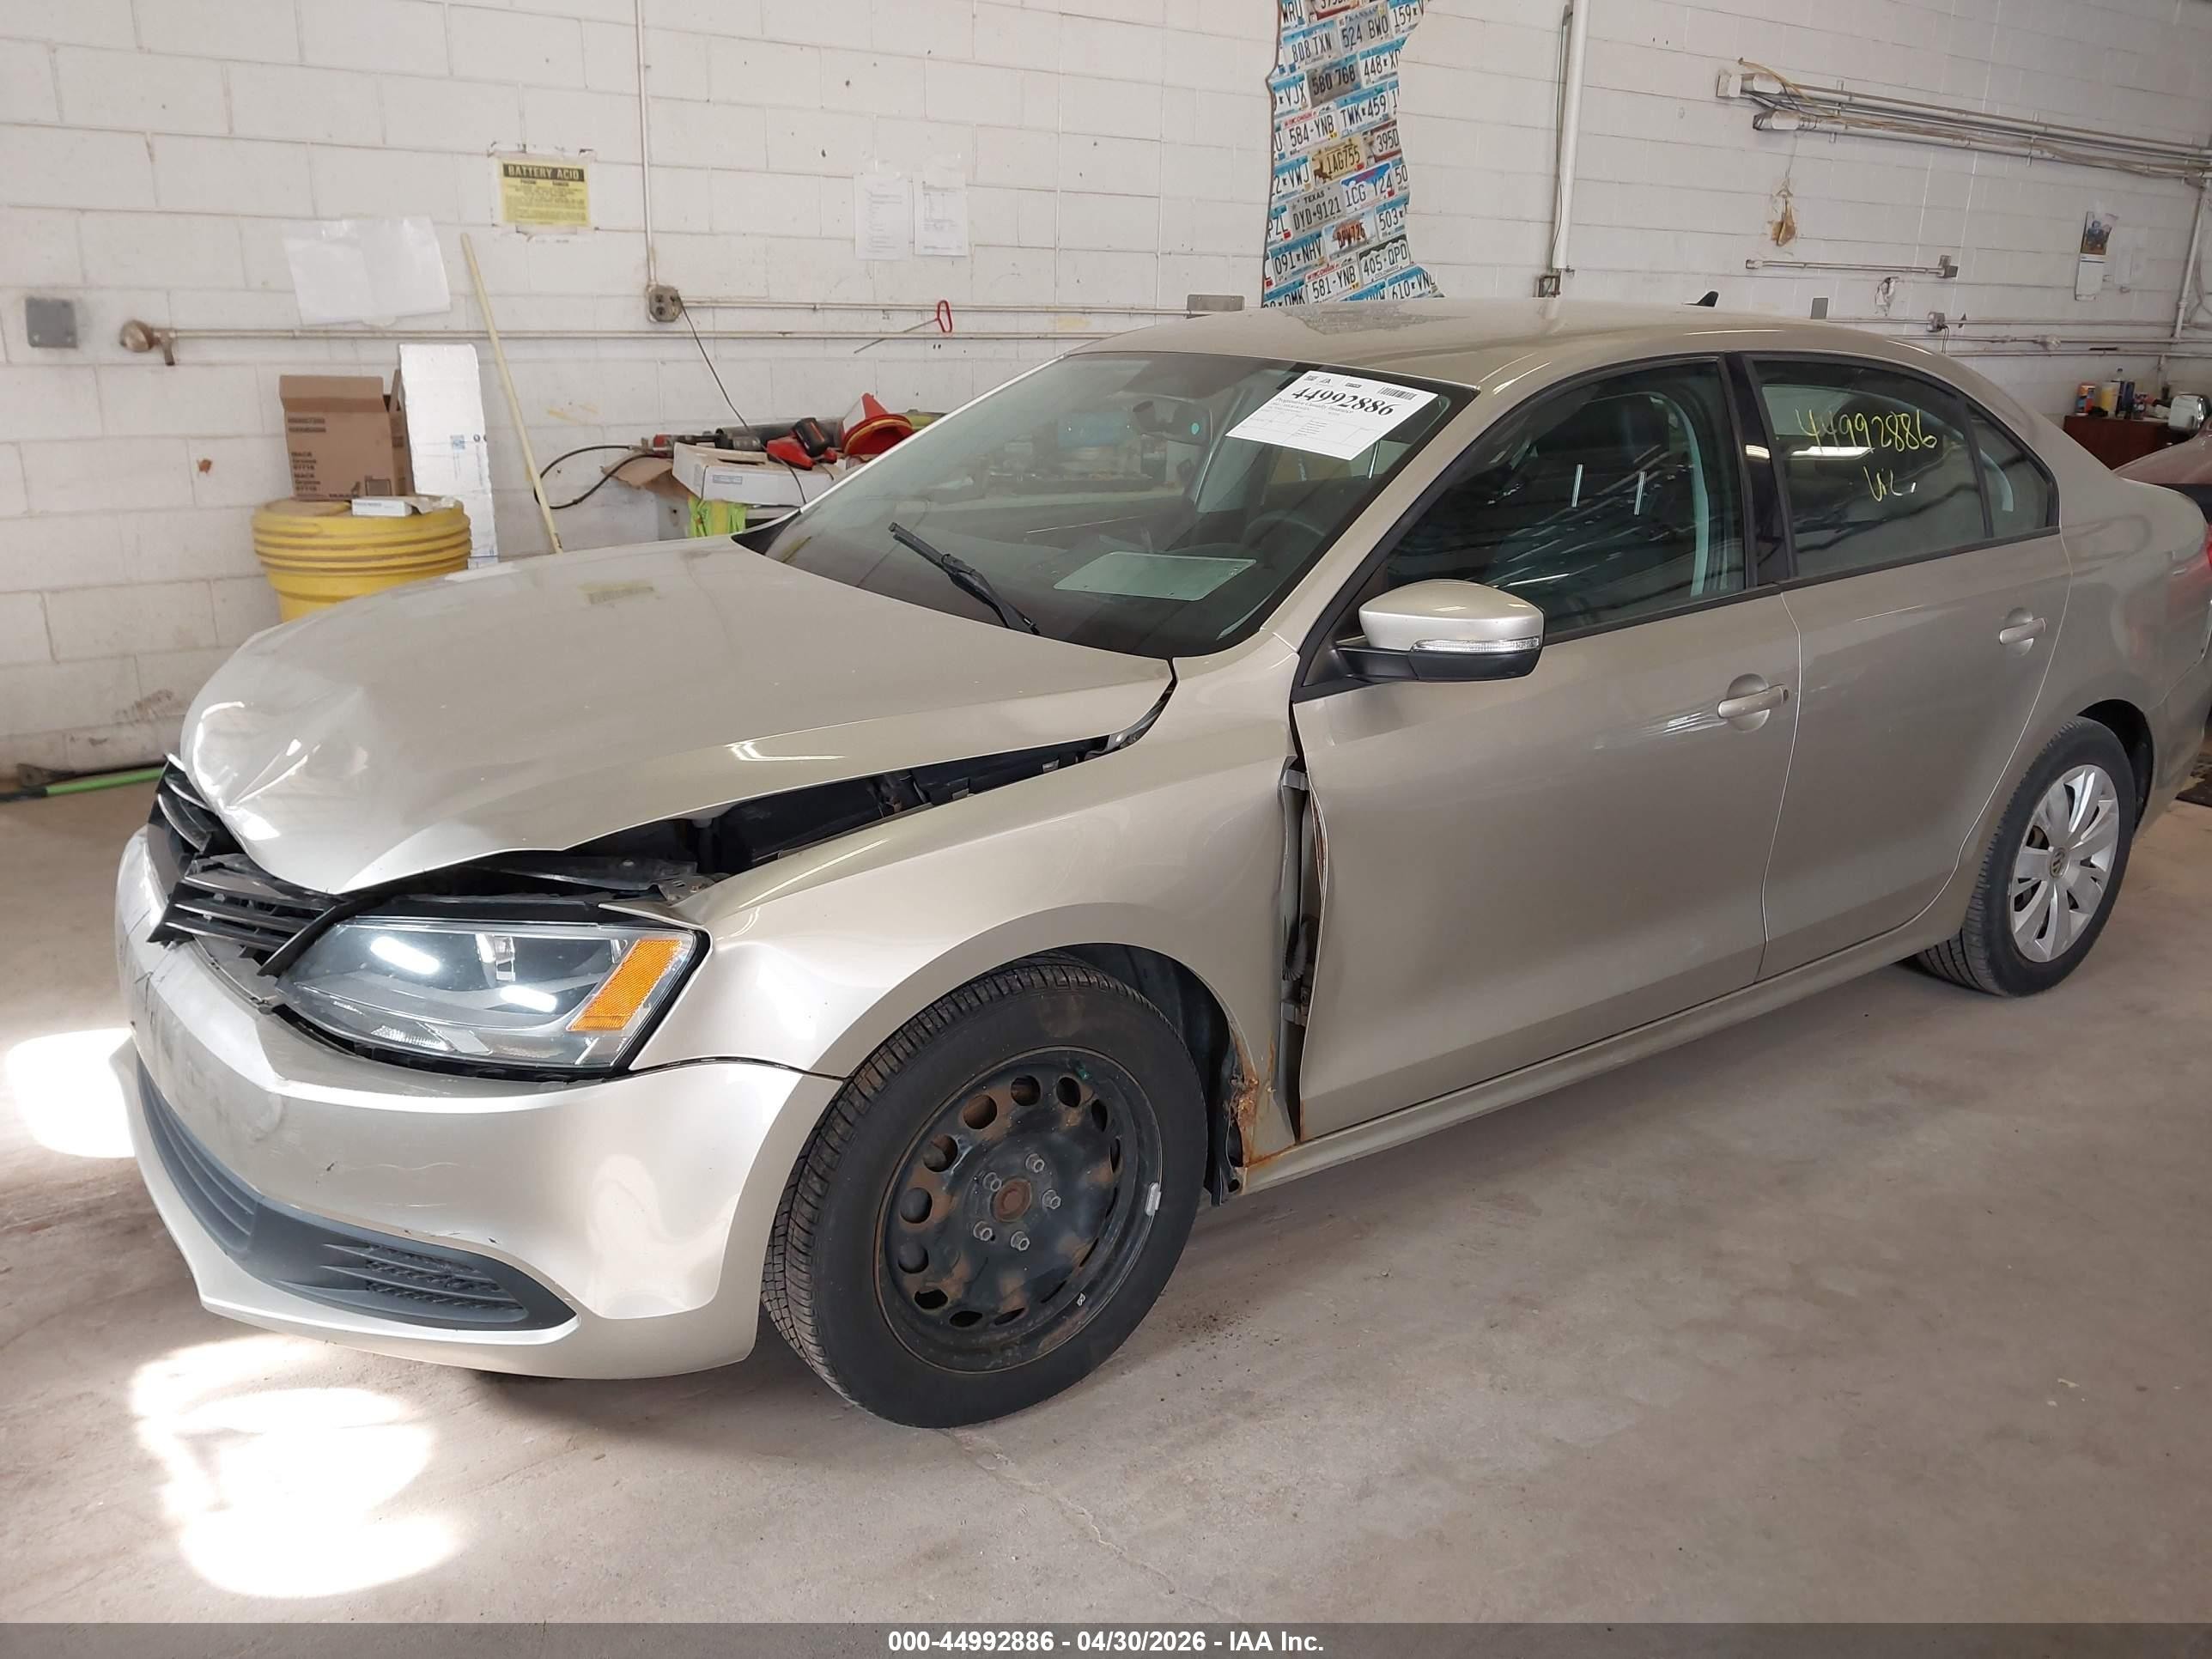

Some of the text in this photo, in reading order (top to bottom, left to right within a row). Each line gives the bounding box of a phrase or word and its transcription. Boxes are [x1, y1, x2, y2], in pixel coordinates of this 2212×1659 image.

[1394, 4, 1411, 27] 159
[1291, 32, 1332, 63] 808 TXN
[1341, 24, 1363, 48] 524
[1364, 55, 1383, 78] 448
[1285, 82, 1306, 106] VJX
[1340, 103, 1363, 129] TWK
[1367, 94, 1387, 118] 459
[1289, 115, 1334, 148] 584-YNB
[507, 164, 580, 179] BATTERY ACID
[1288, 163, 1310, 188] VWJ
[1304, 190, 1325, 204] TEXAS
[1372, 173, 1393, 197] Y24
[1379, 208, 1399, 231] 503
[1274, 239, 1322, 275] 091 NHV
[1311, 265, 1356, 300] 581-YNB
[1291, 386, 1401, 416] 44992886
[1796, 409, 1937, 453] 44992886
